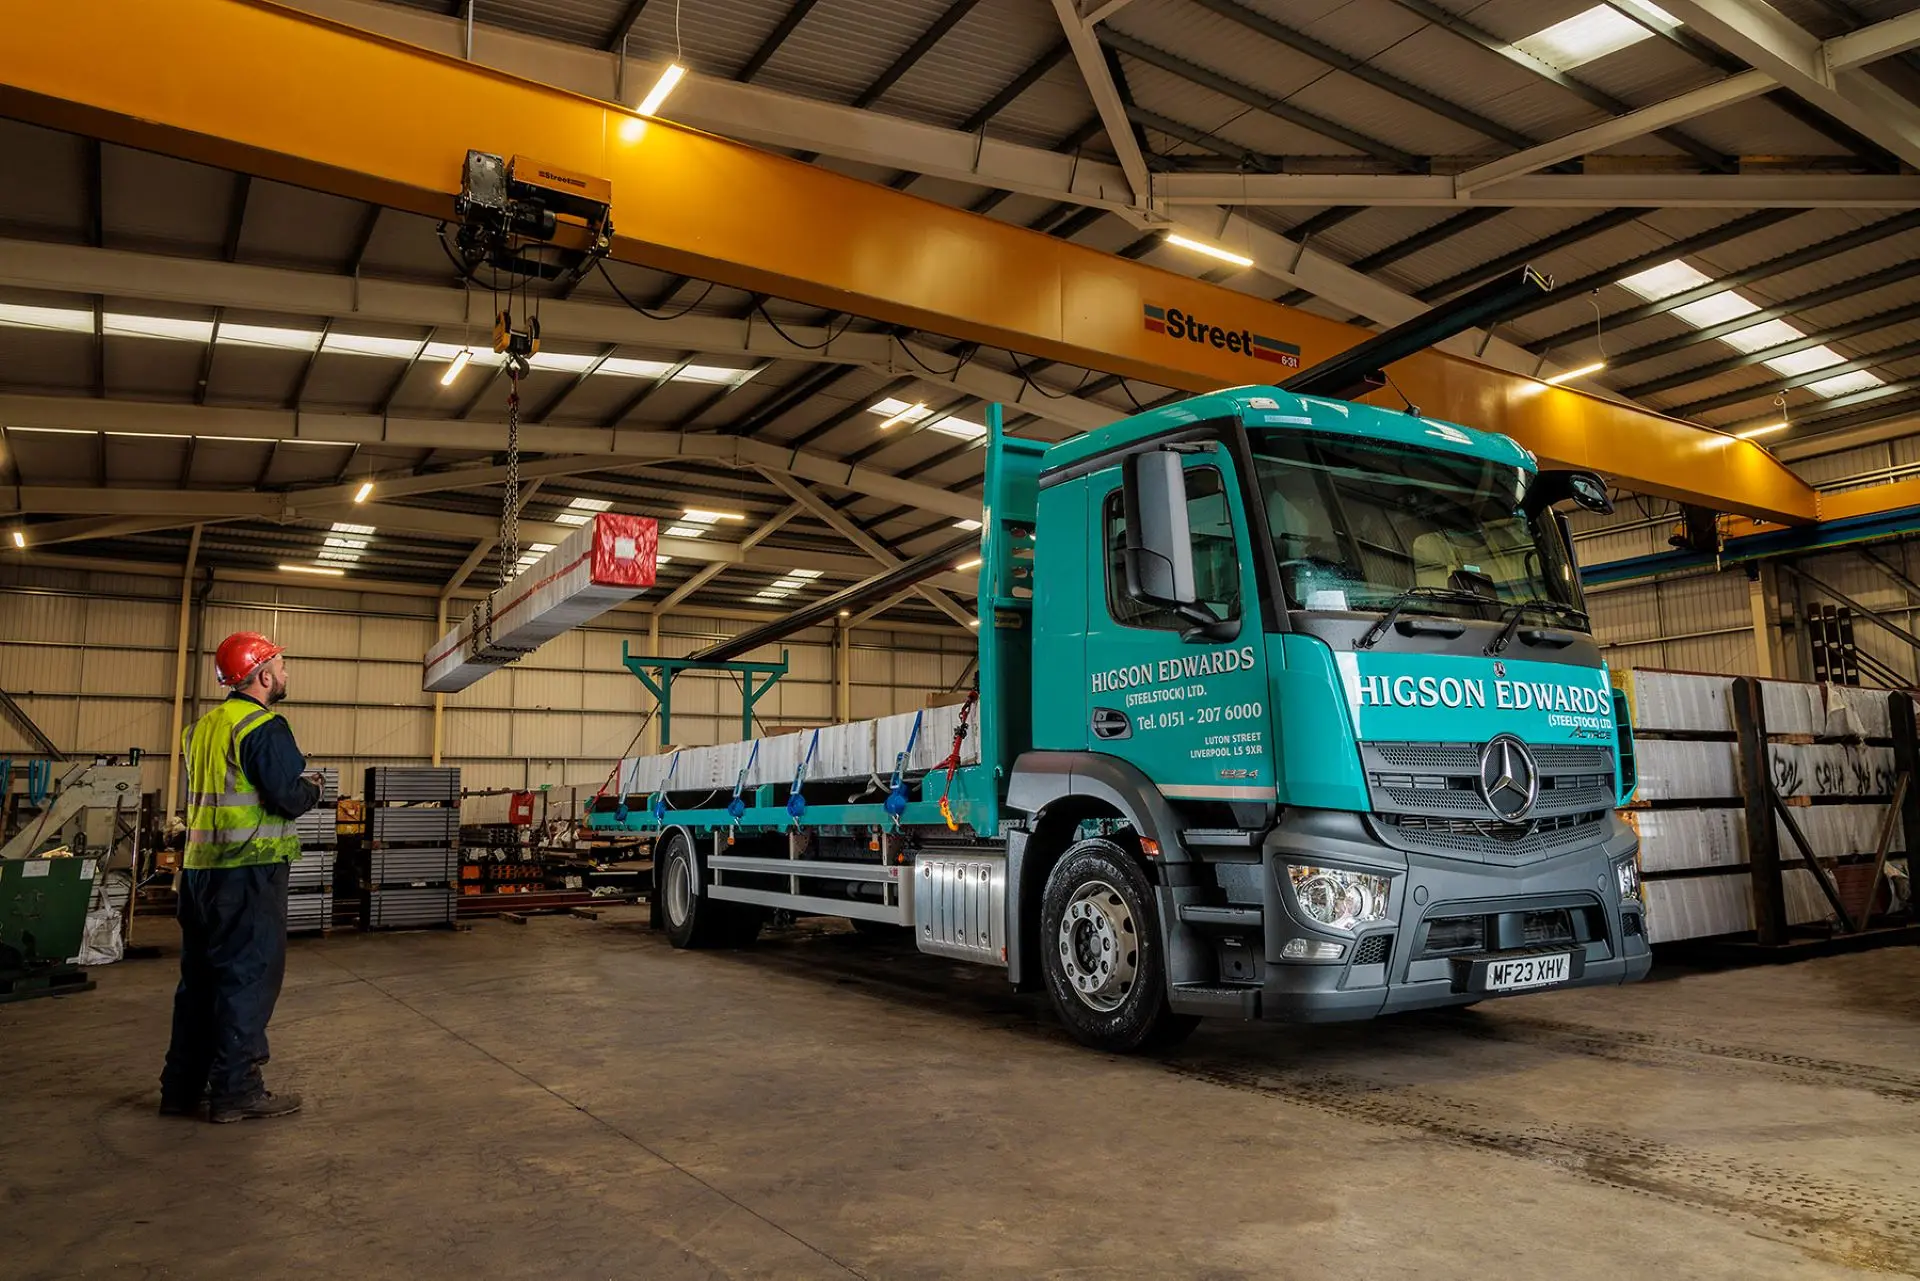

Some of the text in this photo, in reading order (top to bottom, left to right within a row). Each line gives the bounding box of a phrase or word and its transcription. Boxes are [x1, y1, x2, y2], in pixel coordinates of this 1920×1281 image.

[1166, 308, 1253, 357] Street
[1091, 646, 1256, 693] HIGSON EDWARDS
[1125, 684, 1207, 708] (STEELSTOCK) LTD.
[1351, 675, 1612, 717] HIGSON EDWARDS
[1137, 715, 1157, 731] Tel.
[1159, 712, 1185, 729] 0151
[1197, 707, 1221, 724] 207
[1224, 702, 1262, 721] 6000
[1548, 714, 1600, 730] (STEELSTOCK)
[1190, 747, 1231, 759] LIVERPOOL
[1245, 744, 1262, 756] 9XR
[1204, 732, 1262, 745] LUTON STREET
[1493, 958, 1564, 985] MF23 XHV
